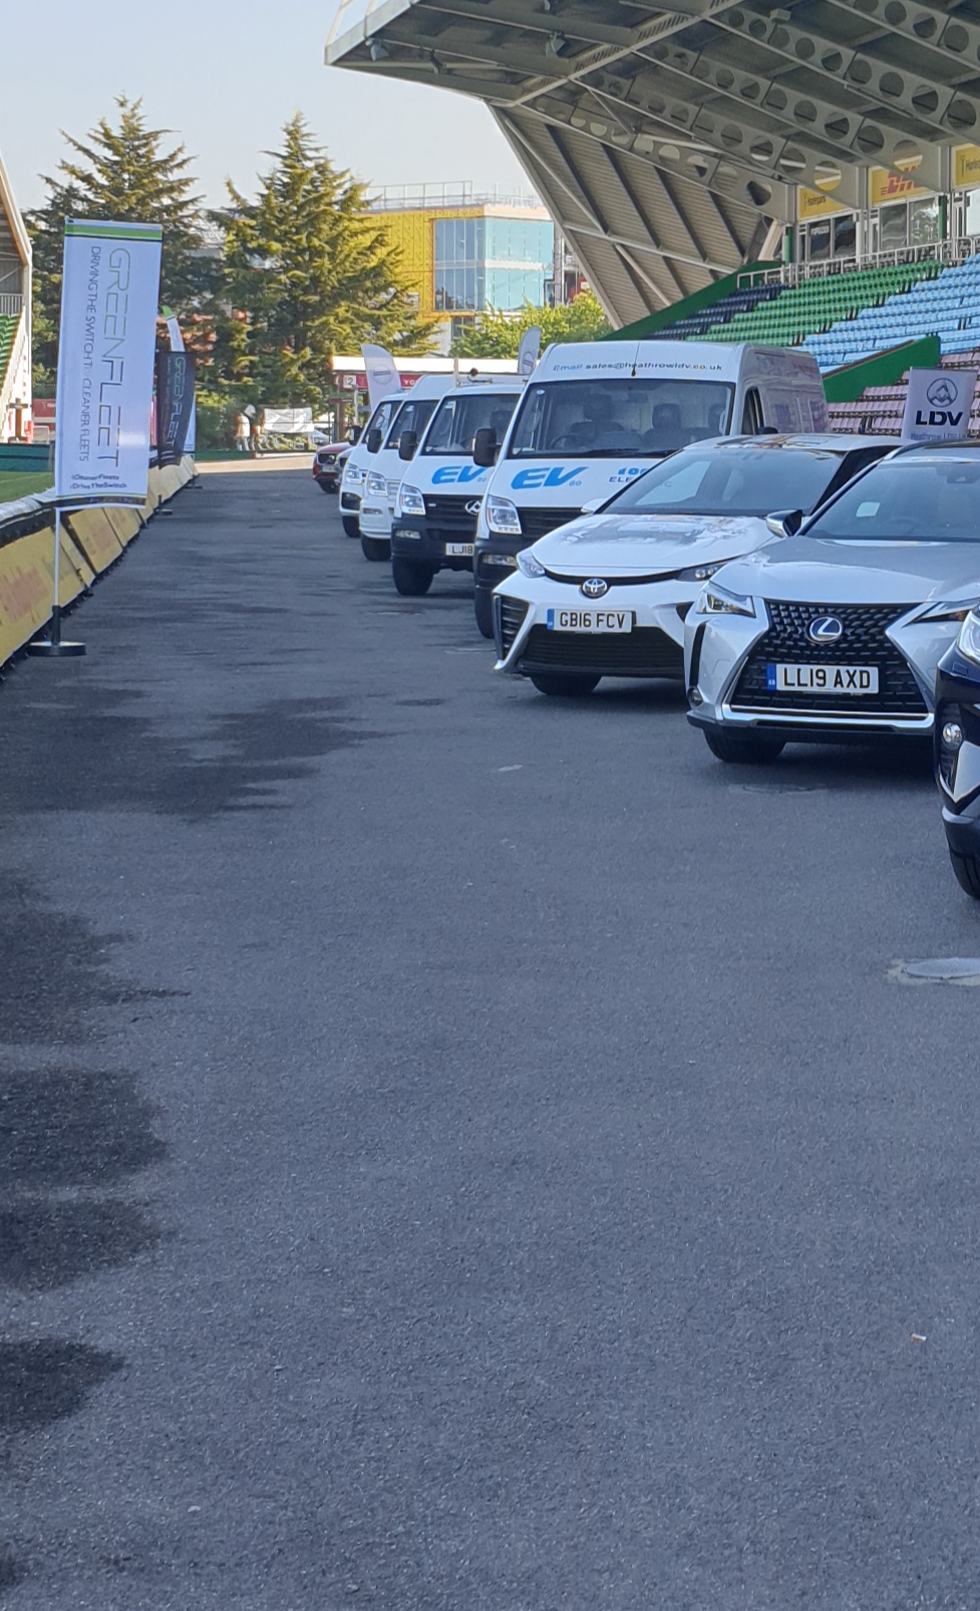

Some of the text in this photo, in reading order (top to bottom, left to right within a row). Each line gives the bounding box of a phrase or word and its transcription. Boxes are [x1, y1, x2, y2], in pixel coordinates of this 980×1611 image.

[87, 246, 101, 291] DRIVING
[86, 293, 98, 313] THE
[83, 316, 96, 362] SWITCH
[97, 247, 131, 467] GREENFLEET
[552, 363, 583, 372] Email
[80, 378, 92, 427] CLEANER
[166, 356, 186, 447] GREENFLEET
[915, 410, 963, 426] LDV
[79, 429, 91, 462] FLEETS
[431, 465, 488, 486] EV
[511, 466, 588, 490] EV
[451, 544, 473, 555] LJ18
[559, 612, 591, 629] GB16
[596, 613, 626, 629] FCV
[783, 667, 871, 689] LL19 AXD
